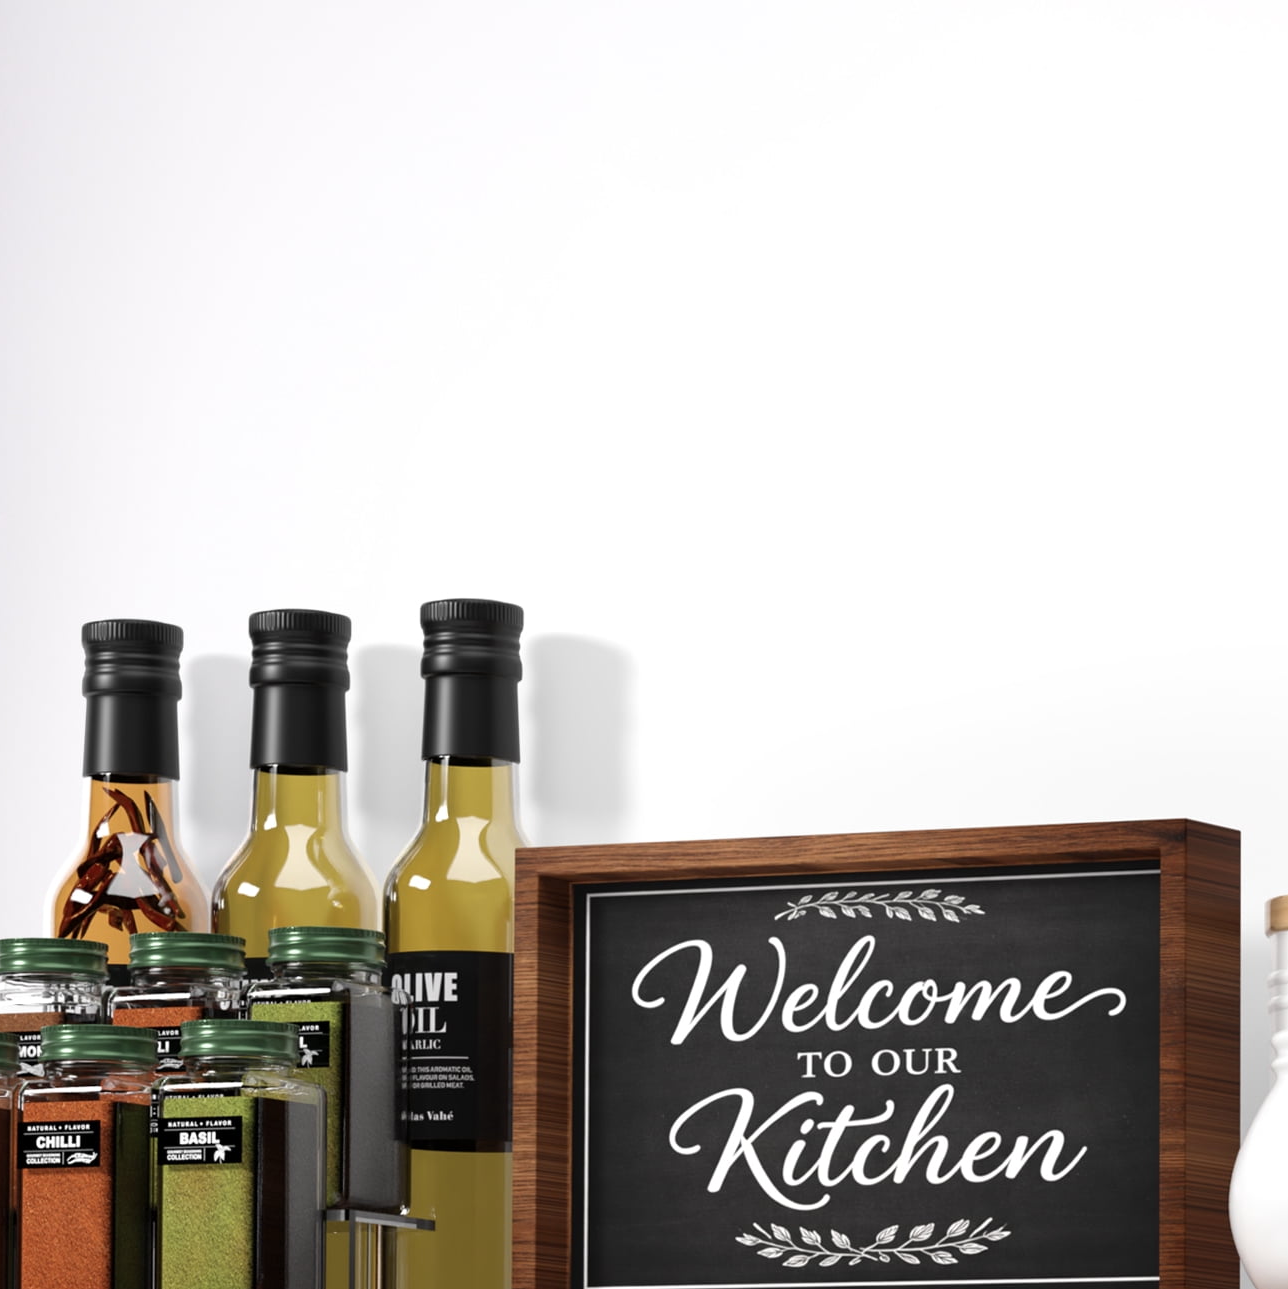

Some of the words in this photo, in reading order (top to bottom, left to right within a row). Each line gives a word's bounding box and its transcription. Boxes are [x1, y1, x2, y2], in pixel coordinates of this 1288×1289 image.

[631, 935, 1127, 1046] Welcome
[797, 1051, 853, 1078] TO
[871, 1047, 962, 1077] OUR
[36, 1135, 81, 1149] CHILLI
[179, 1131, 220, 1145] BASIL
[669, 1083, 1088, 1211] Kitchen
